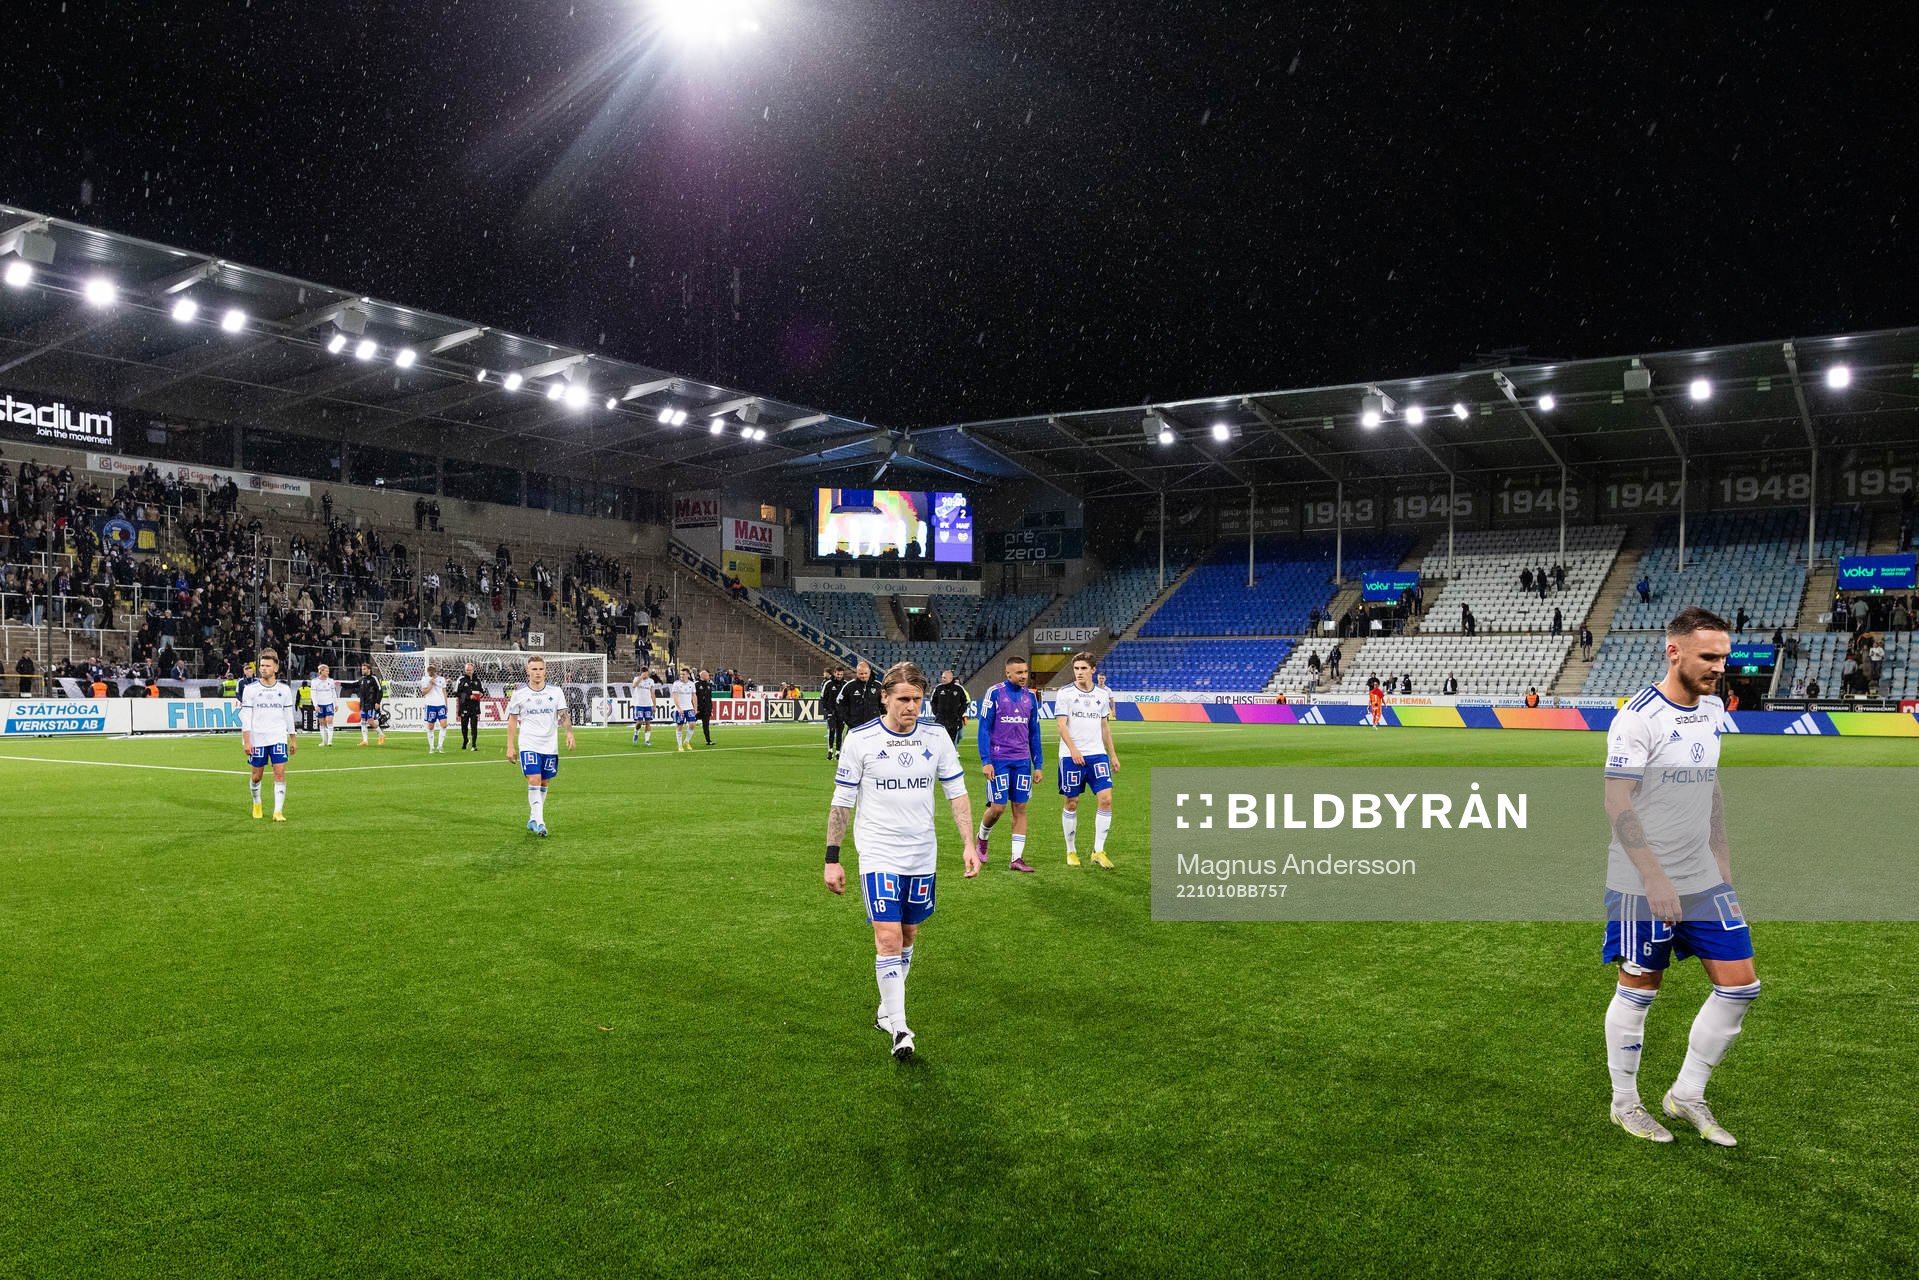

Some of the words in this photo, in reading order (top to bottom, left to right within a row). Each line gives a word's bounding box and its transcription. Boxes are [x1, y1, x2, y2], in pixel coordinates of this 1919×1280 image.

[36, 427, 53, 437] Join
[54, 429, 68, 439] the
[69, 433, 113, 445] movement
[1719, 473, 1811, 503] 1948
[1843, 467, 1918, 496] 195
[1496, 487, 1581, 515] 1946
[1606, 480, 1688, 509] 1947
[674, 498, 718, 517] MAXI
[1304, 499, 1374, 525] 1943
[1393, 493, 1473, 520] 1945
[960, 509, 967, 519] 2
[734, 519, 773, 543] MAXI
[1004, 547, 1046, 560] zero
[1842, 566, 1875, 577] voky
[822, 582, 846, 591] Ocab
[884, 583, 908, 592] Ocab
[945, 584, 968, 593] Ocab
[1134, 694, 1160, 702] SEFAB
[1399, 697, 1433, 705] HEMMA
[16, 702, 100, 716] STÅTHÖGA
[167, 701, 243, 729] Flink
[617, 700, 677, 720] Thmia
[710, 703, 760, 718] AMO
[797, 699, 825, 721] XL
[1071, 711, 1101, 719] HOLMEN
[15, 719, 75, 732] VERKSTAD
[77, 719, 99, 731] AB
[1674, 714, 1709, 725] stadium
[886, 739, 922, 748] stadium
[873, 899, 887, 913] 18
[1643, 941, 1652, 956] 6
